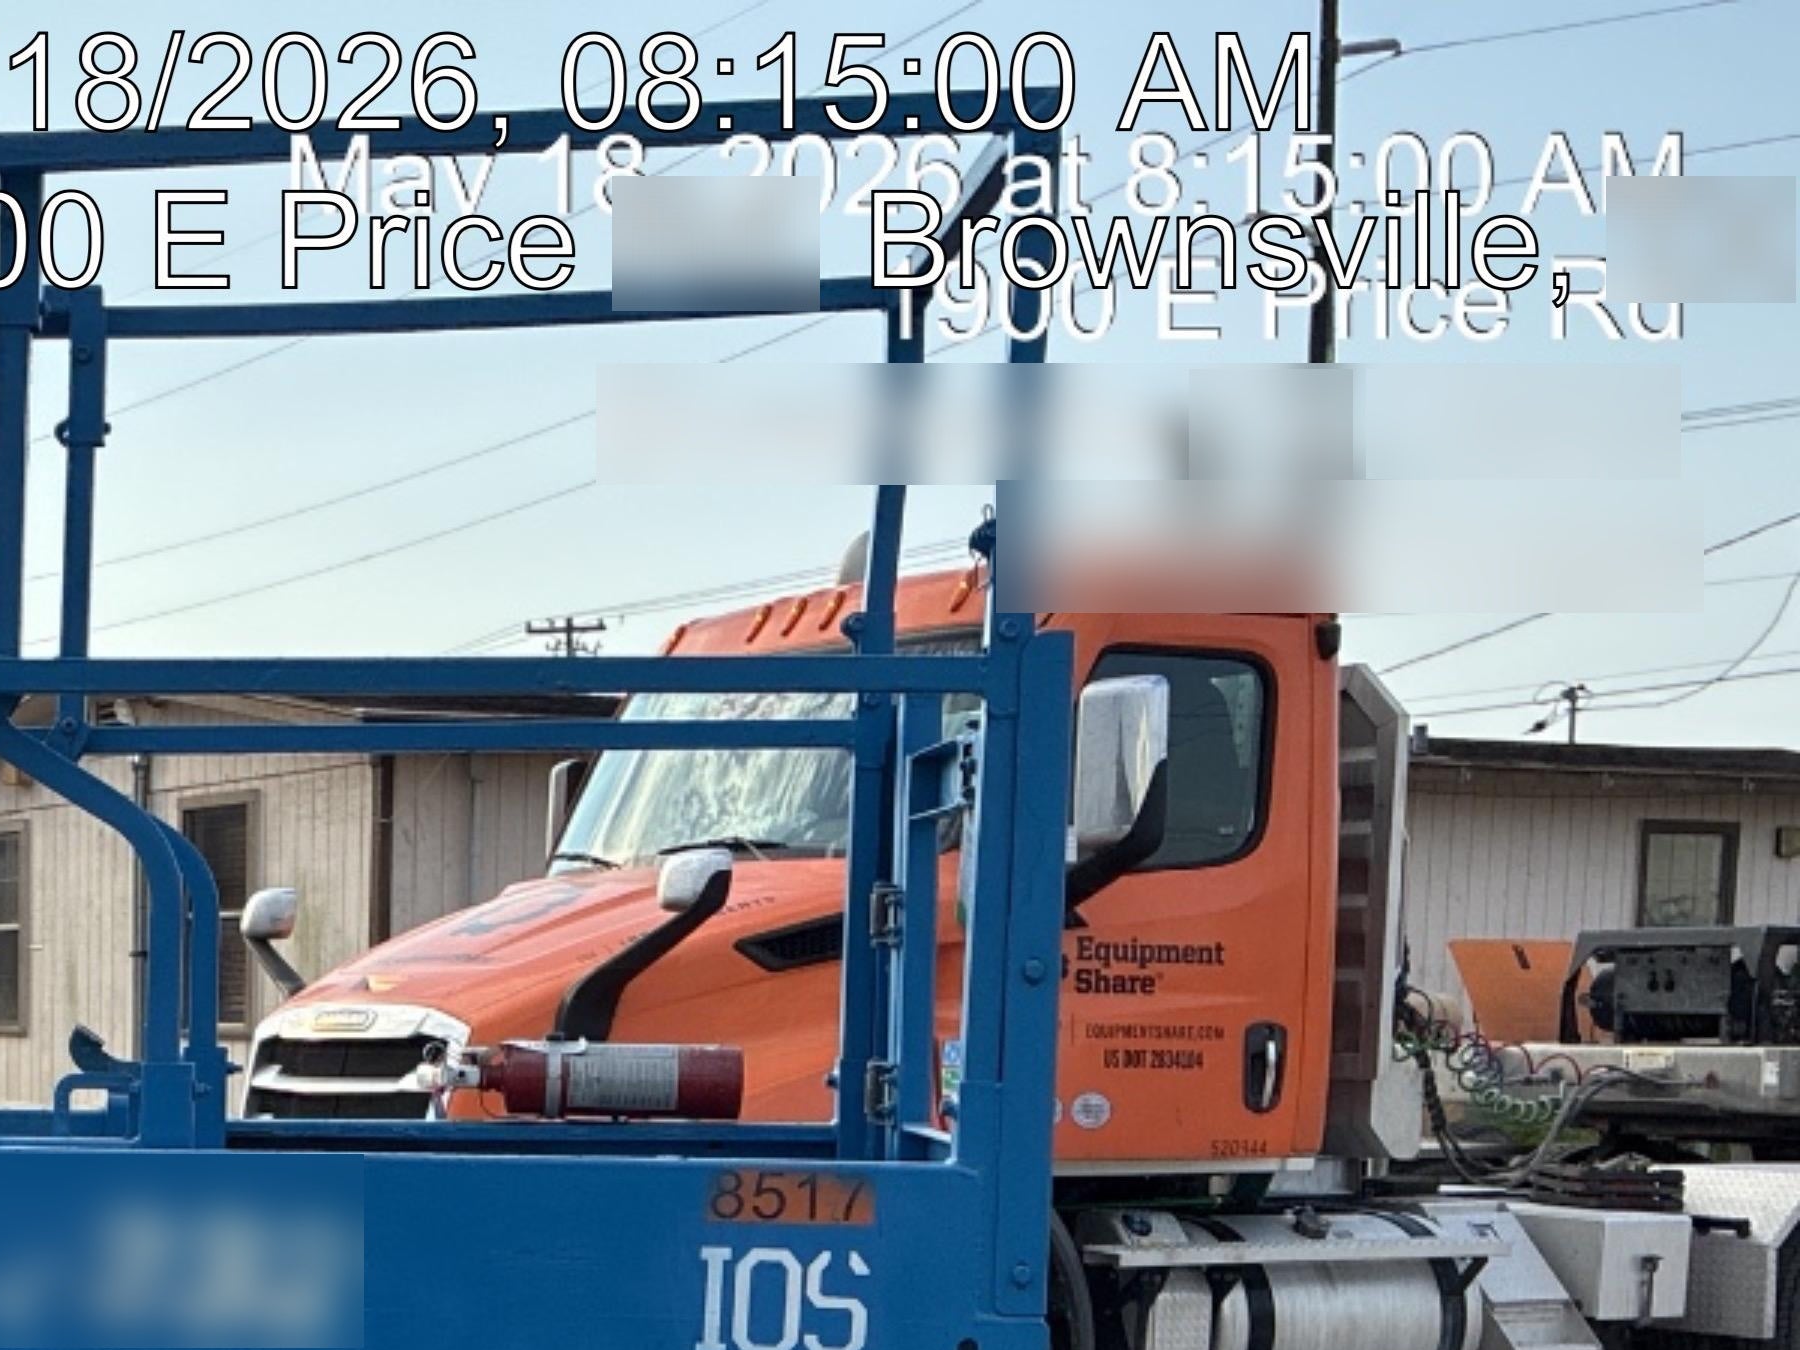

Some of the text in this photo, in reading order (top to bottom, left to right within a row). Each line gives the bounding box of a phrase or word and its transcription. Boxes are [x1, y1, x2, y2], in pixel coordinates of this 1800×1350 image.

[1076, 936, 1225, 969] Equipment
[1074, 969, 1157, 995] Share
[710, 1170, 865, 1222] 8517
